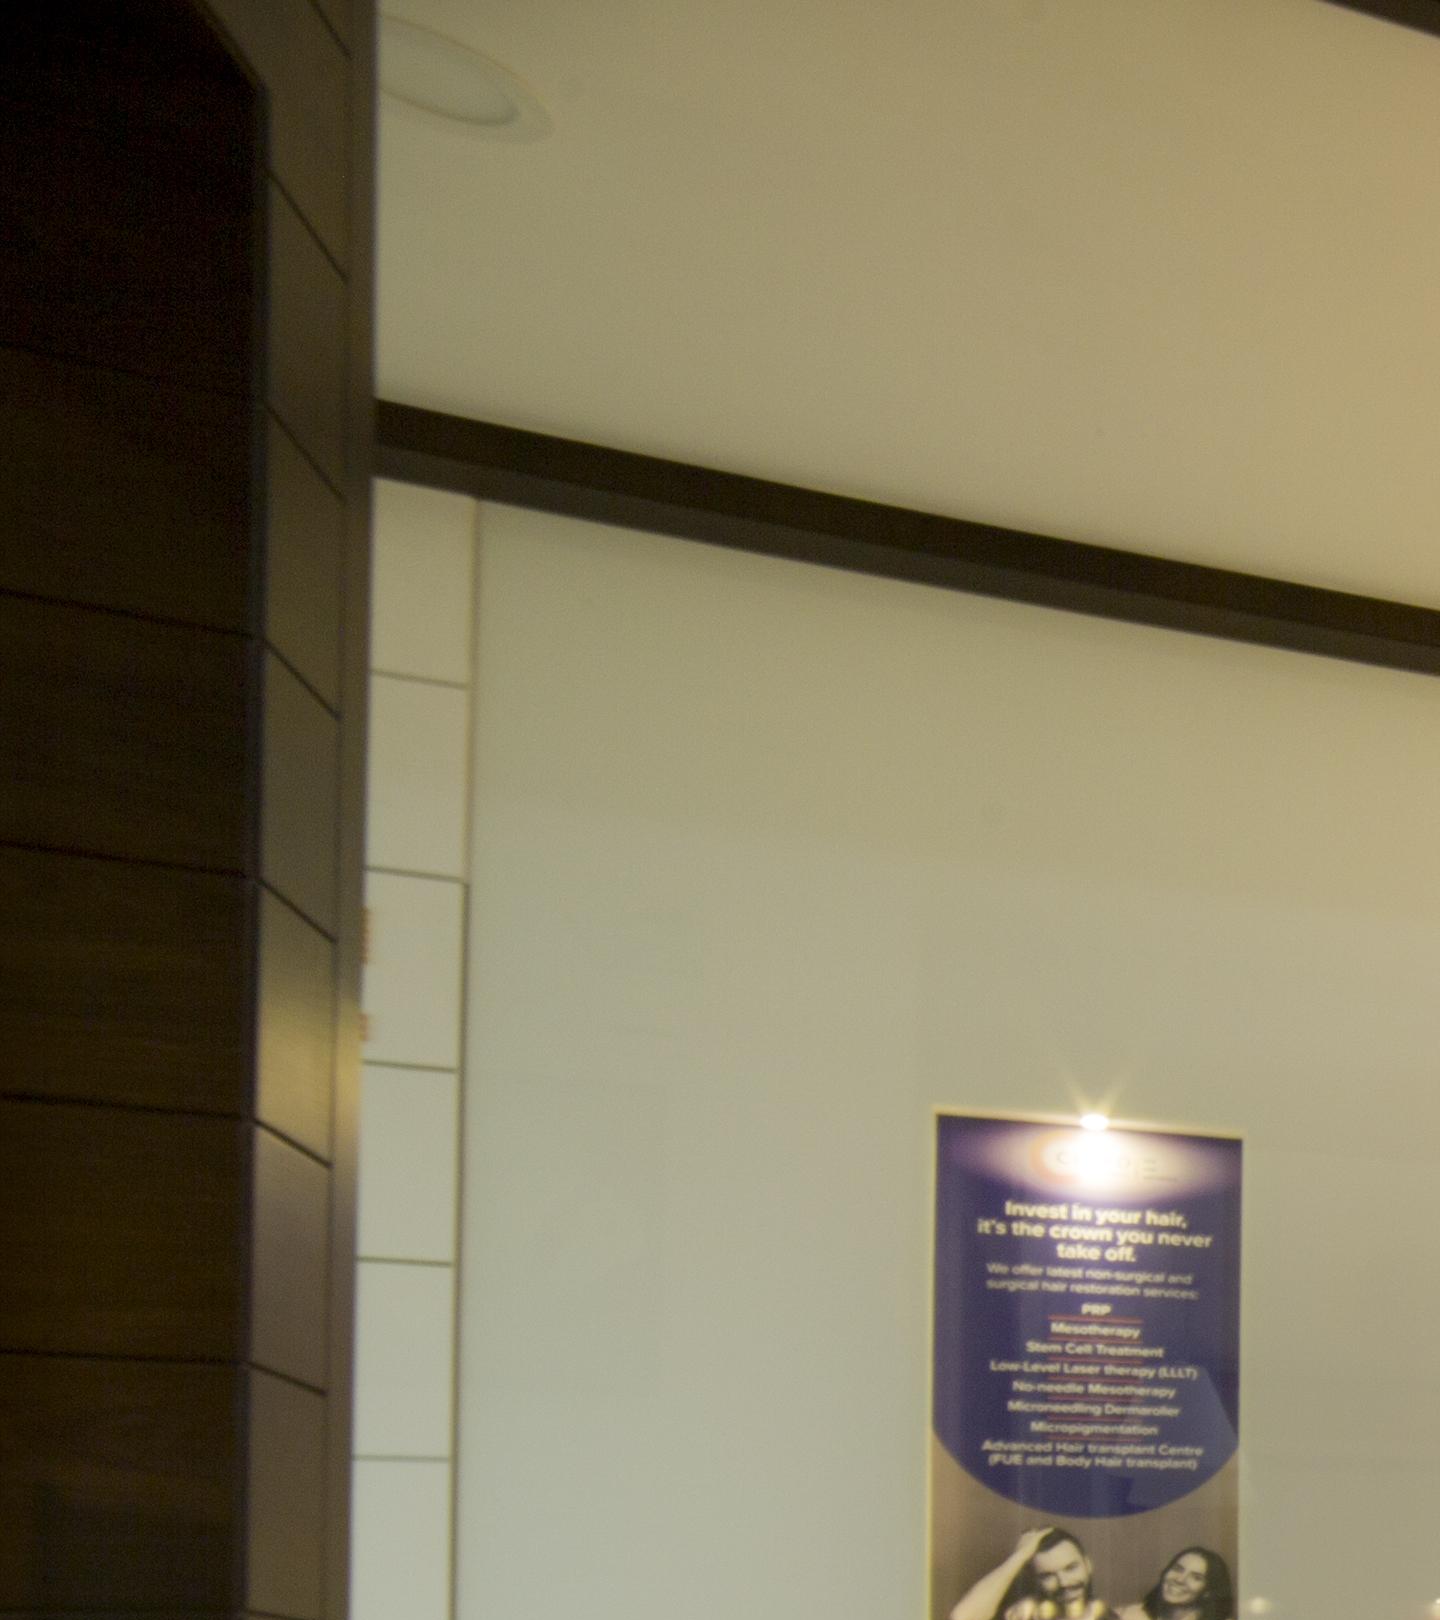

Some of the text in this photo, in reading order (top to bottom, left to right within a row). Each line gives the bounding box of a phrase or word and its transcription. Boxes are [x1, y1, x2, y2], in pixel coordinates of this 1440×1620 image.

[1005, 1201, 1188, 1229] Invest in your hair,
[977, 1218, 1213, 1249] it's the crown you never
[1056, 1243, 1137, 1263] take off.
[985, 1262, 1009, 1275] We
[1011, 1263, 1043, 1276] offer
[1167, 1272, 1194, 1284] and
[1041, 1280, 1067, 1292] hair
[1080, 1302, 1113, 1317] PRP
[1049, 1321, 1142, 1340] Mesotherapy
[1025, 1340, 1165, 1359] Stem Cell Treatment
[1063, 1362, 1101, 1376] Laser
[1103, 1363, 1156, 1380] therapy
[1087, 1382, 1178, 1400] Mesotherapy
[1006, 1400, 1102, 1416] Microneedling
[1029, 1420, 1160, 1437] Micropigmentation
[980, 1438, 1053, 1453] Advanced
[1055, 1441, 1085, 1454] Hair
[1087, 1443, 1155, 1458] transplant
[1025, 1455, 1053, 1467] and
[1056, 1455, 1092, 1470] Body
[1094, 1456, 1123, 1470] Hair
